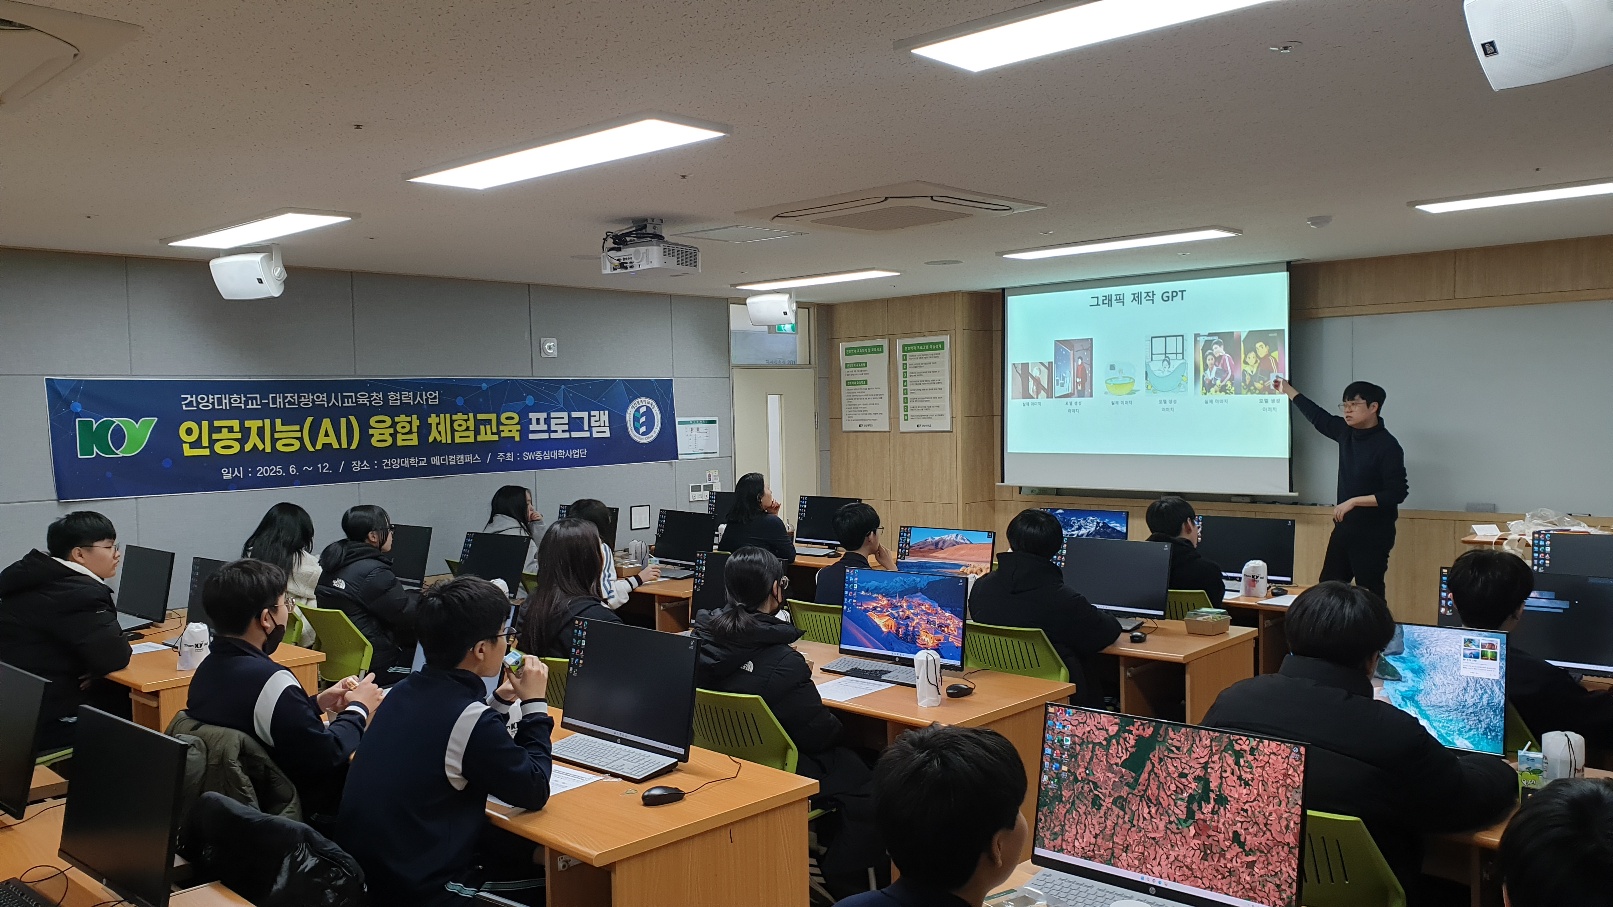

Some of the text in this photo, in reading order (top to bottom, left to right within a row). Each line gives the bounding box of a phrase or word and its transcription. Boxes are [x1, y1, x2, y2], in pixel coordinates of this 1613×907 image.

[1089, 289, 1187, 307] 그래픽 제작 GPT
[181, 391, 439, 410] 건양대학교-대전광역시교육청 협력사업
[179, 416, 360, 456] 인공지능(AI)
[368, 414, 421, 448] 융합
[427, 411, 522, 445] 체험교육
[528, 410, 611, 440] 프로그램
[221, 467, 243, 480] 일시
[256, 465, 286, 477] 2025.
[289, 465, 299, 475] 6.
[317, 462, 333, 473] 12.
[351, 460, 371, 472] 장소
[382, 456, 428, 469] 건양대학교
[430, 453, 482, 466] 메디컬캠퍼스
[497, 452, 514, 463] 주최
[522, 448, 588, 461] SW중심대학사업단
